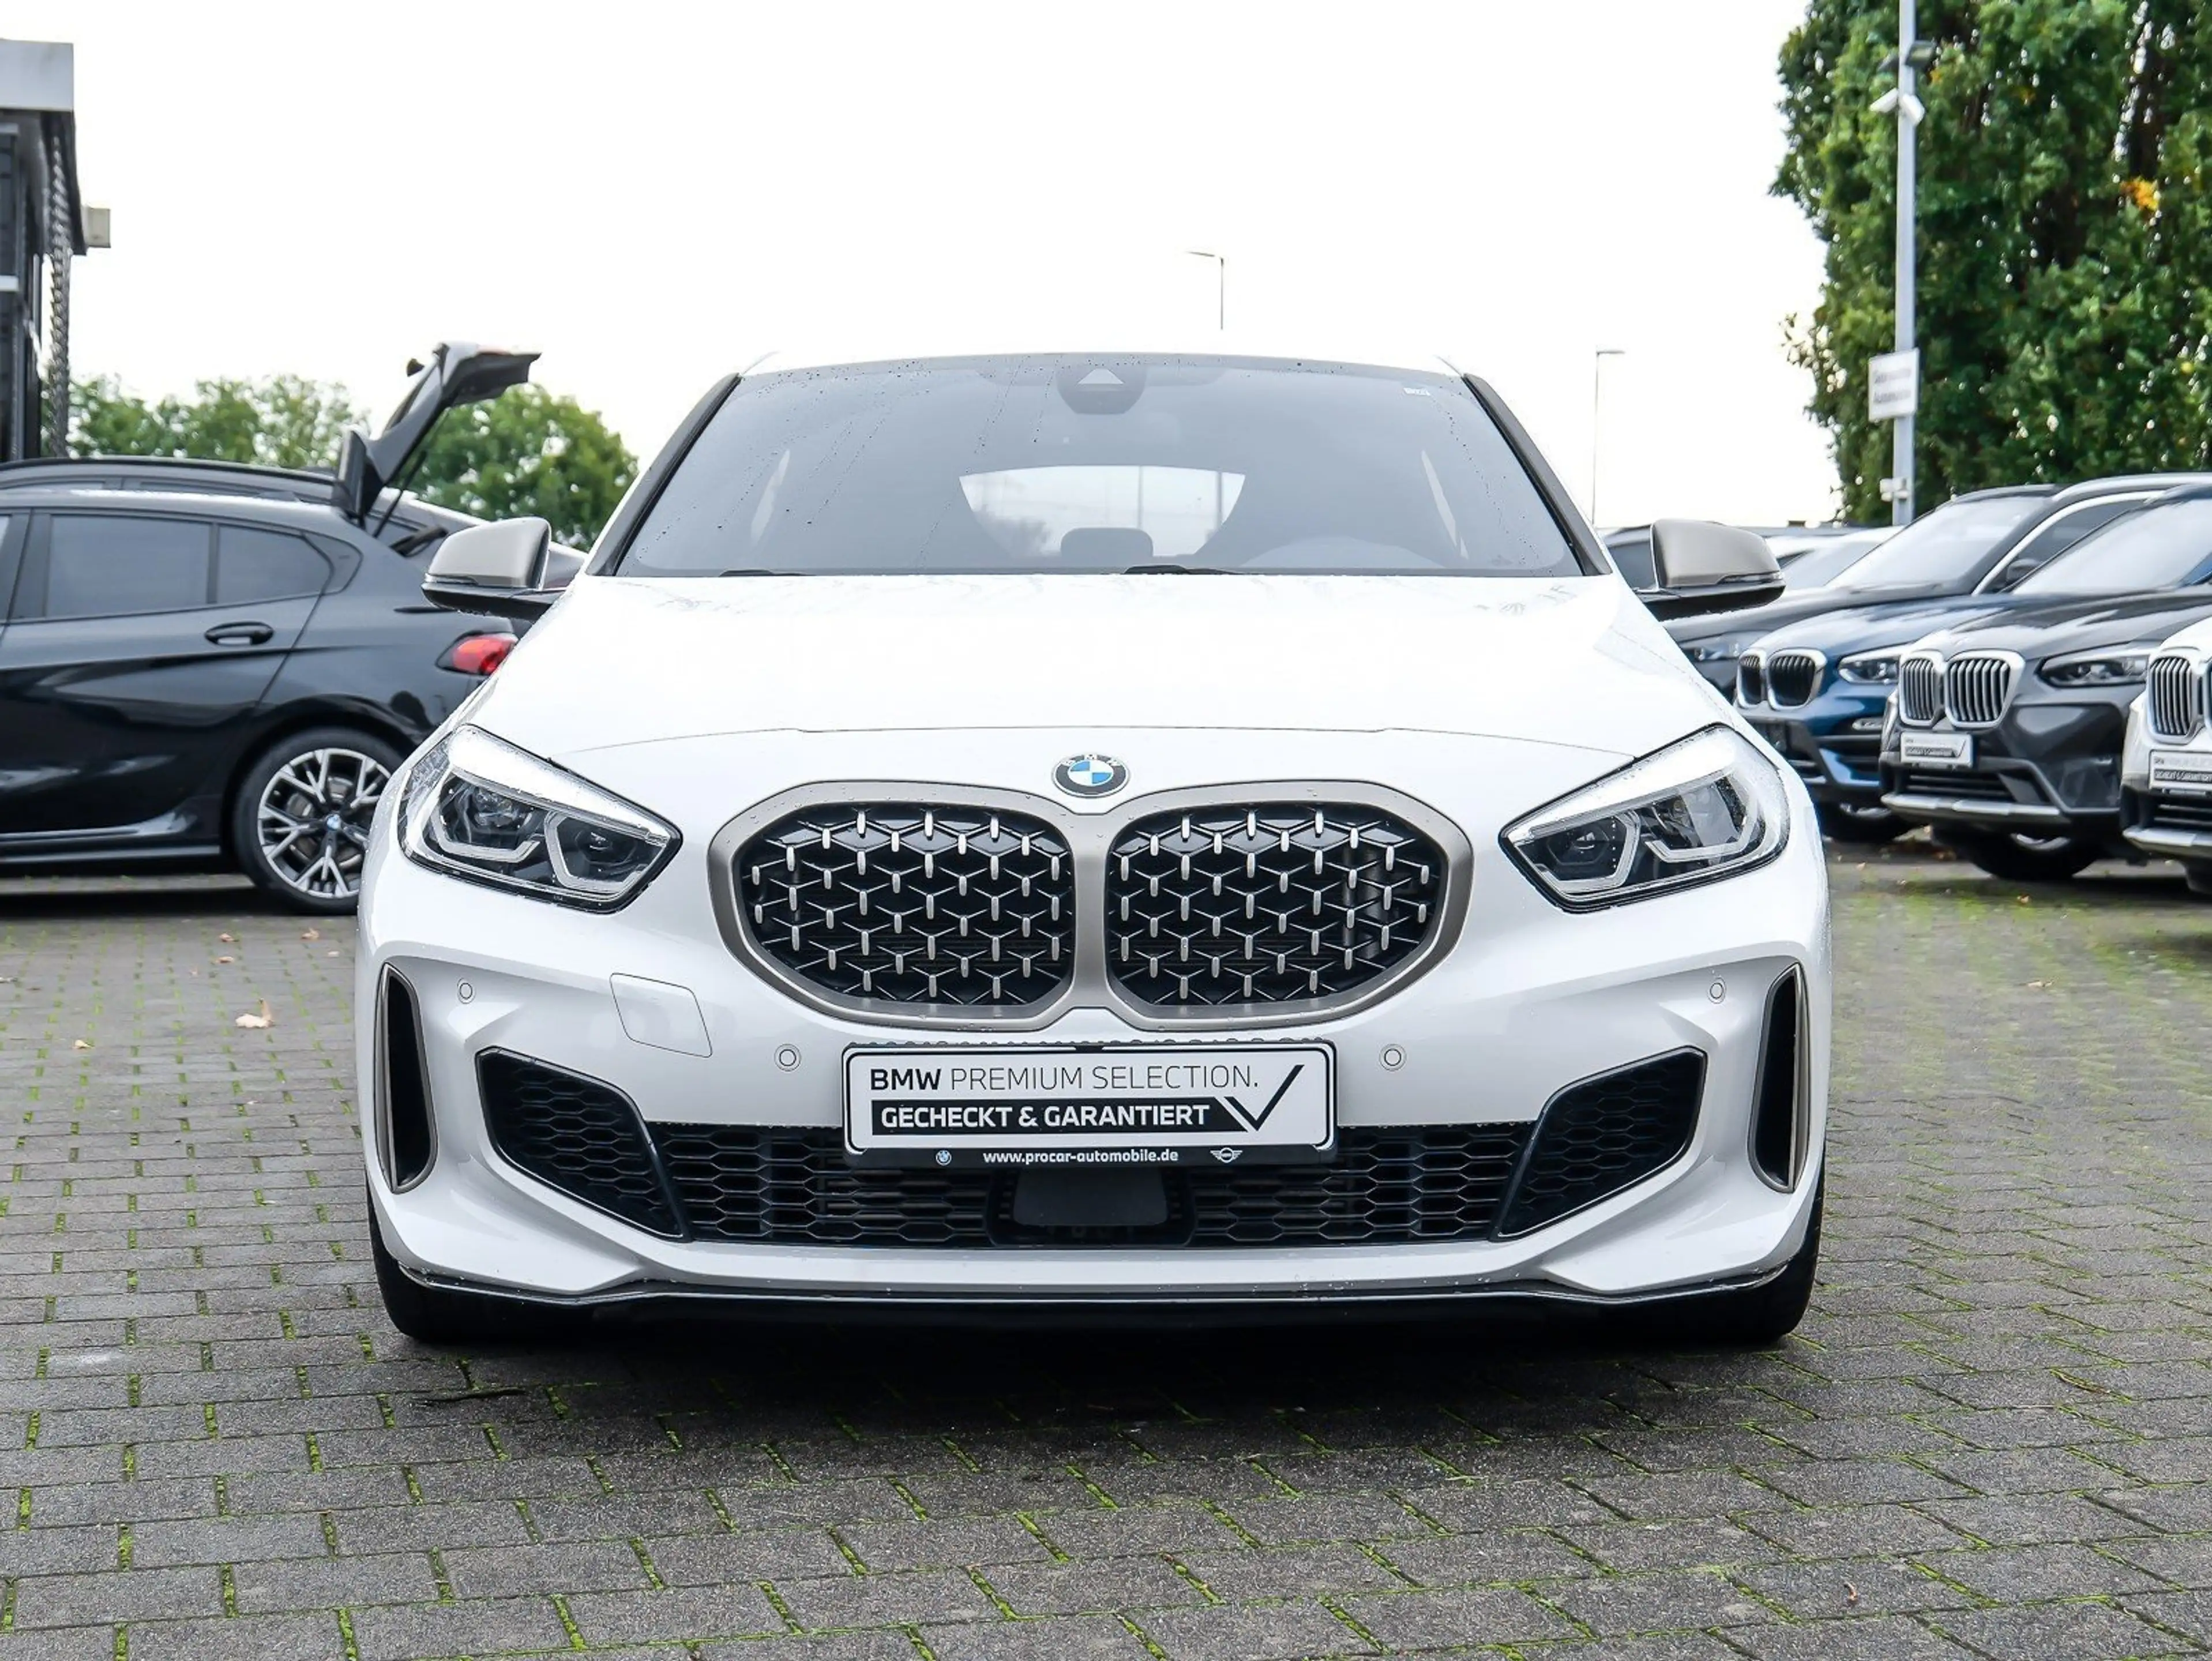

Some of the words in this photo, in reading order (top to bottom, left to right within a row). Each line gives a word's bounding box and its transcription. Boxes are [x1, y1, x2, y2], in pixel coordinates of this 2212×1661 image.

[870, 1068, 941, 1090] BMW
[951, 1066, 1082, 1090] PREMIUM
[1092, 1065, 1258, 1089] SELECTION.
[881, 1106, 1013, 1128] GECHECKT
[1018, 1106, 1038, 1127] &
[1043, 1104, 1210, 1126] GARANTIERT
[982, 1148, 1178, 1164] www.procar-automobile.de
